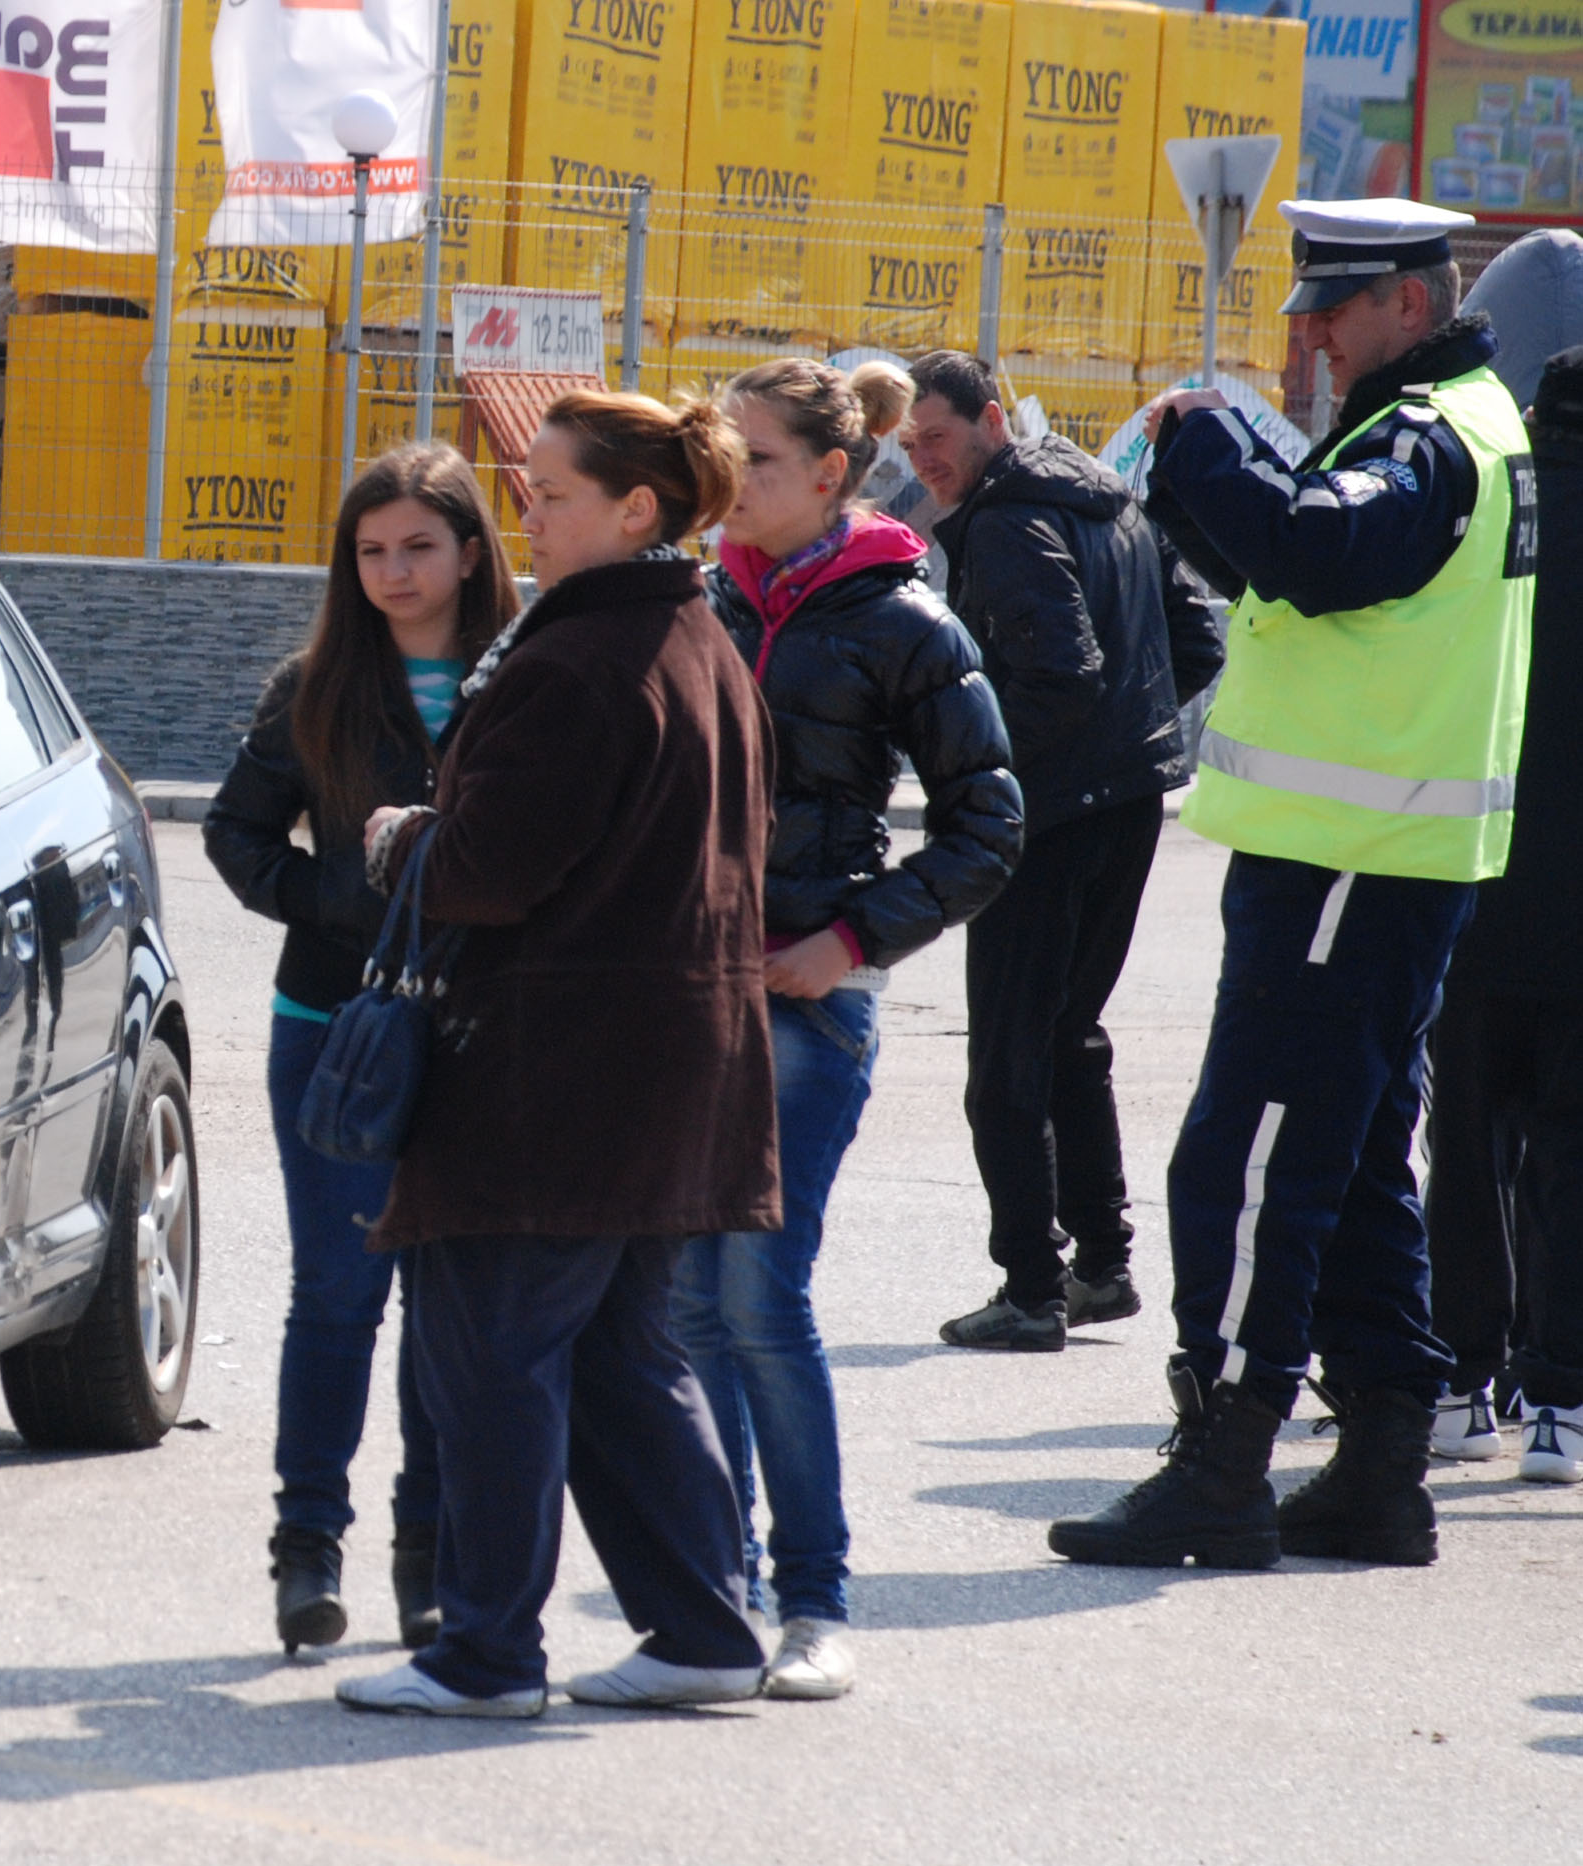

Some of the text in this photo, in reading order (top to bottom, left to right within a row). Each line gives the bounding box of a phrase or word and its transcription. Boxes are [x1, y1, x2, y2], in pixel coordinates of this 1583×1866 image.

[569, 0, 665, 47] YTONG
[729, 0, 825, 38] YTONG
[1024, 61, 1122, 114] YTONG
[883, 90, 969, 146] YTONG
[716, 165, 810, 213] YTONG
[193, 246, 298, 287] YTONG
[1026, 227, 1107, 269] YTONG
[869, 254, 958, 301] YTONG
[1177, 263, 1253, 308] YTNG
[185, 475, 286, 521] YTONG
